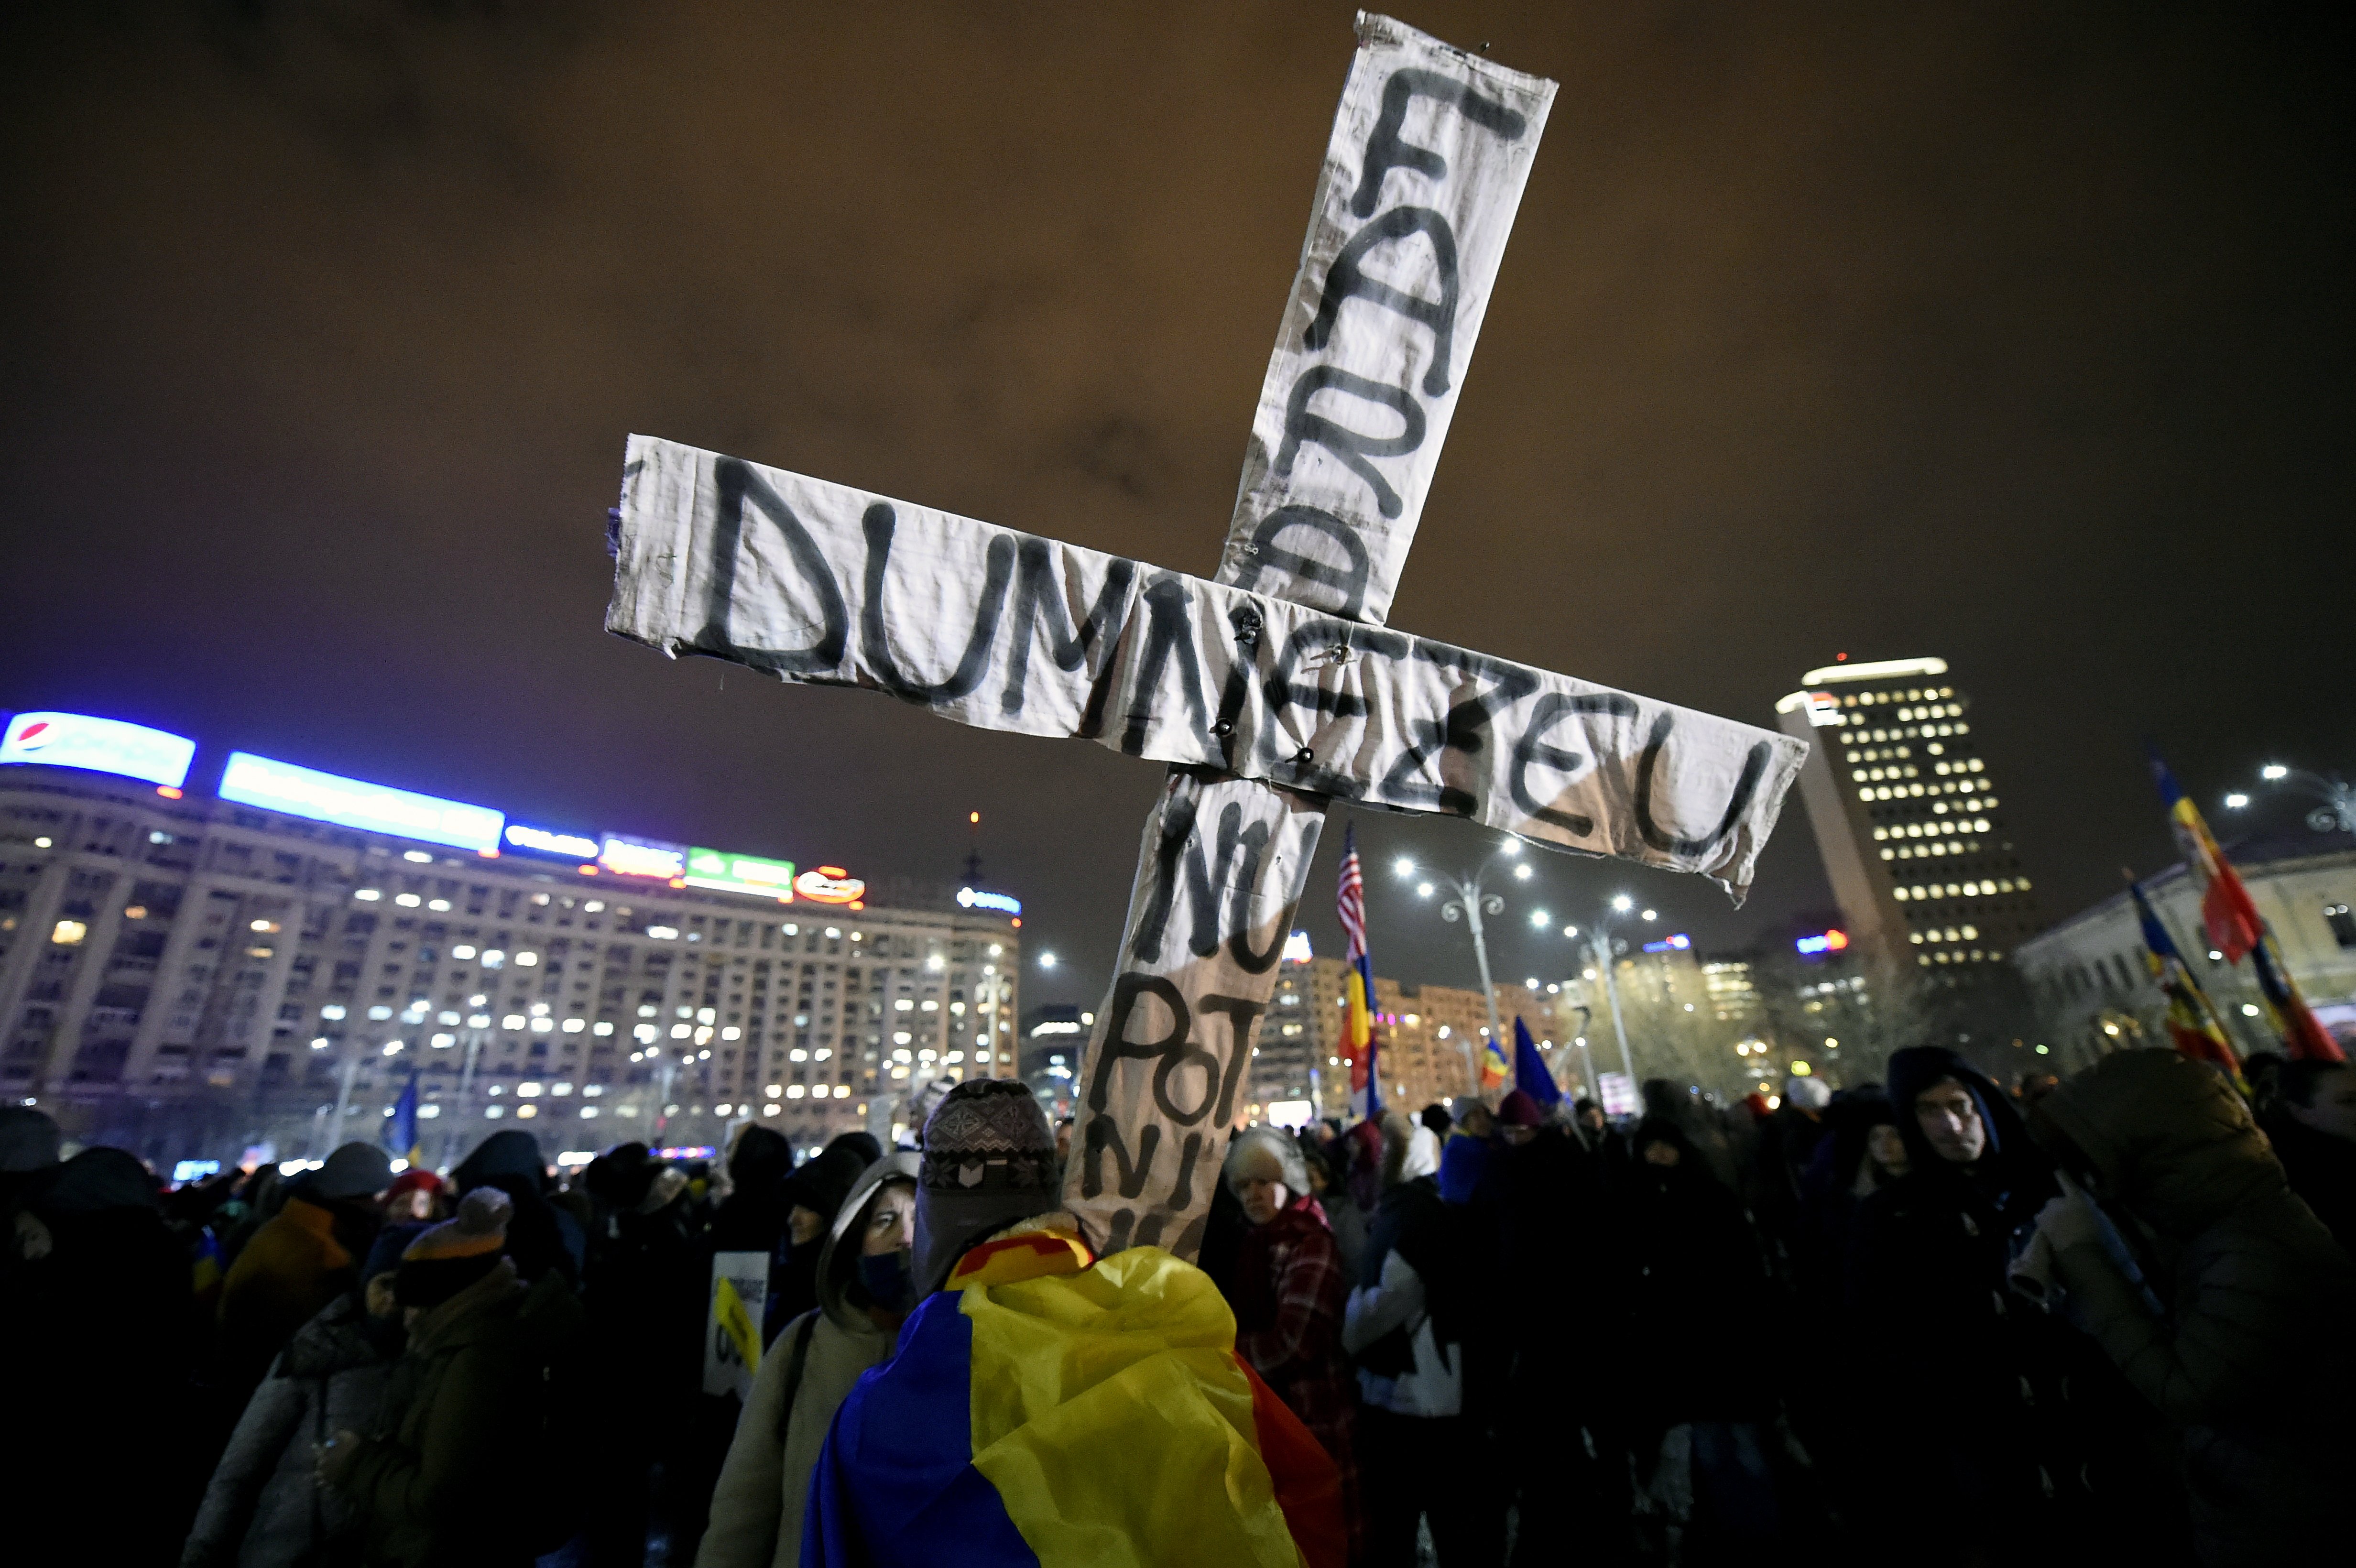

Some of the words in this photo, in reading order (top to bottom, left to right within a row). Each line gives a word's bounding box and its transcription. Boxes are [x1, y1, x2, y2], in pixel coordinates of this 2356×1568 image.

[1232, 66, 1526, 621] FARA
[692, 454, 1773, 857] DUMNEZEU
[1131, 795, 1321, 975] NU
[1087, 970, 1266, 1129] POT
